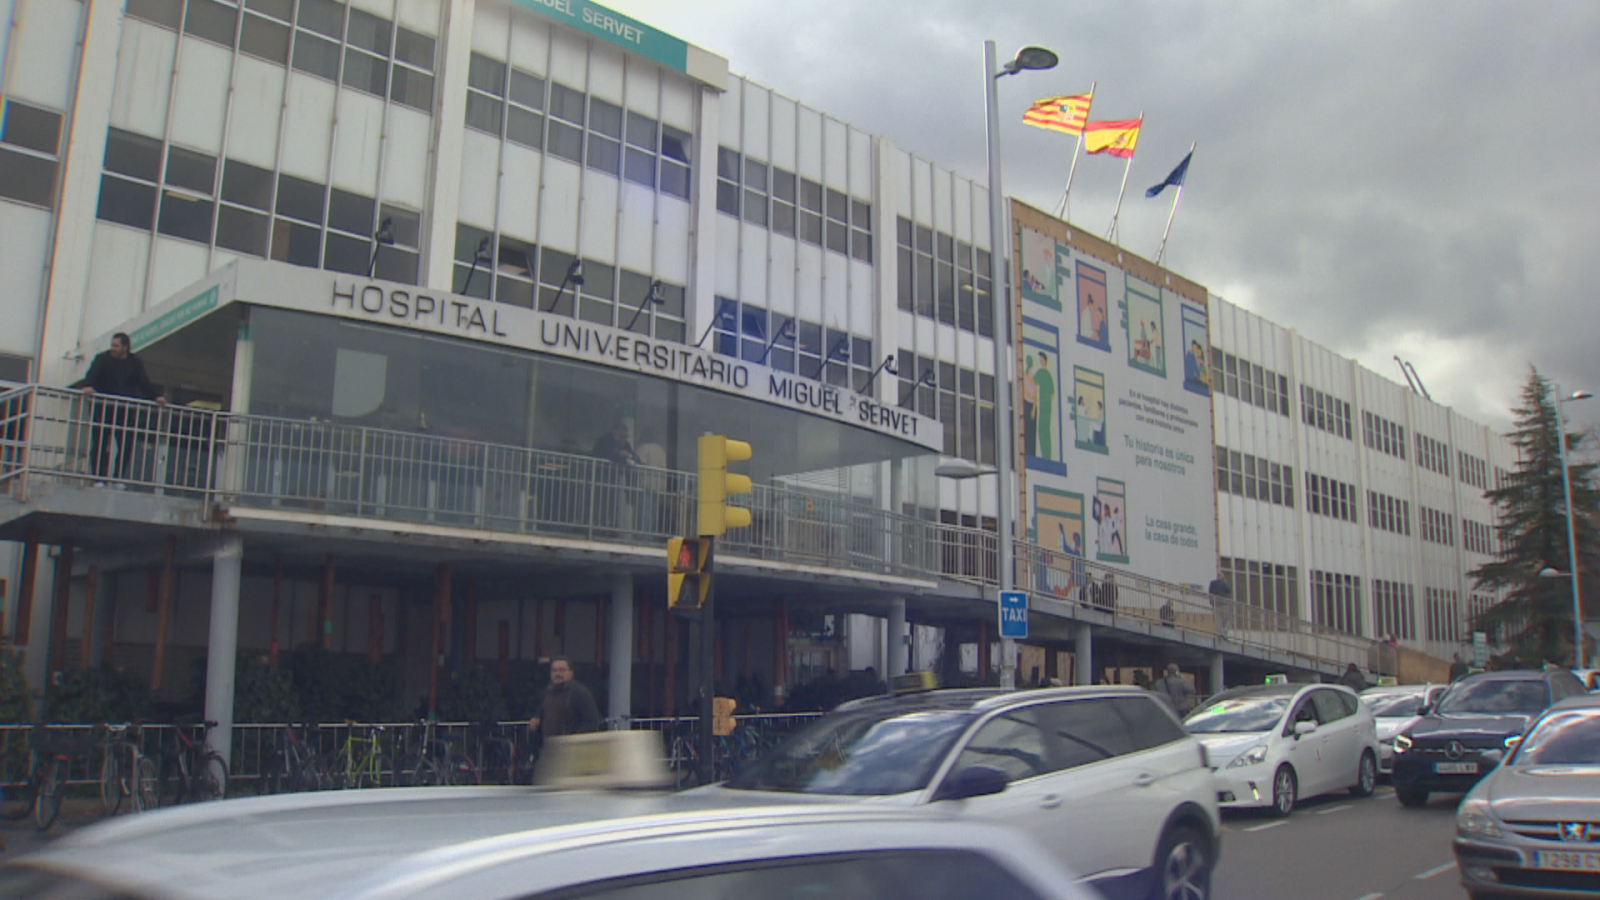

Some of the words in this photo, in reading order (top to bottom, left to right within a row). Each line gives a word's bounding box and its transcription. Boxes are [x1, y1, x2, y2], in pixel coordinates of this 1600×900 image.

[582, 6, 644, 44] SERVET
[332, 280, 507, 337] HOSPITAL
[541, 318, 749, 389] UNIVERSITARIO
[769, 374, 843, 415] MIGUEL
[858, 400, 919, 437] SERVET
[1124, 434, 1134, 449] Tu
[1135, 437, 1164, 456] historia
[1165, 447, 1174, 459] es
[1175, 448, 1194, 464] única
[1135, 454, 1152, 467] para
[1153, 459, 1186, 476] nosotros
[1145, 514, 1154, 527] La
[1155, 519, 1172, 531] casa
[1172, 522, 1198, 537] grande,
[1145, 528, 1152, 541] la
[1153, 532, 1169, 544] casa
[1170, 534, 1179, 546] de
[1180, 535, 1198, 549] todos
[1002, 607, 1028, 622] TAXI
[1542, 853, 1580, 868] 1298
[1584, 853, 1600, 868] C
